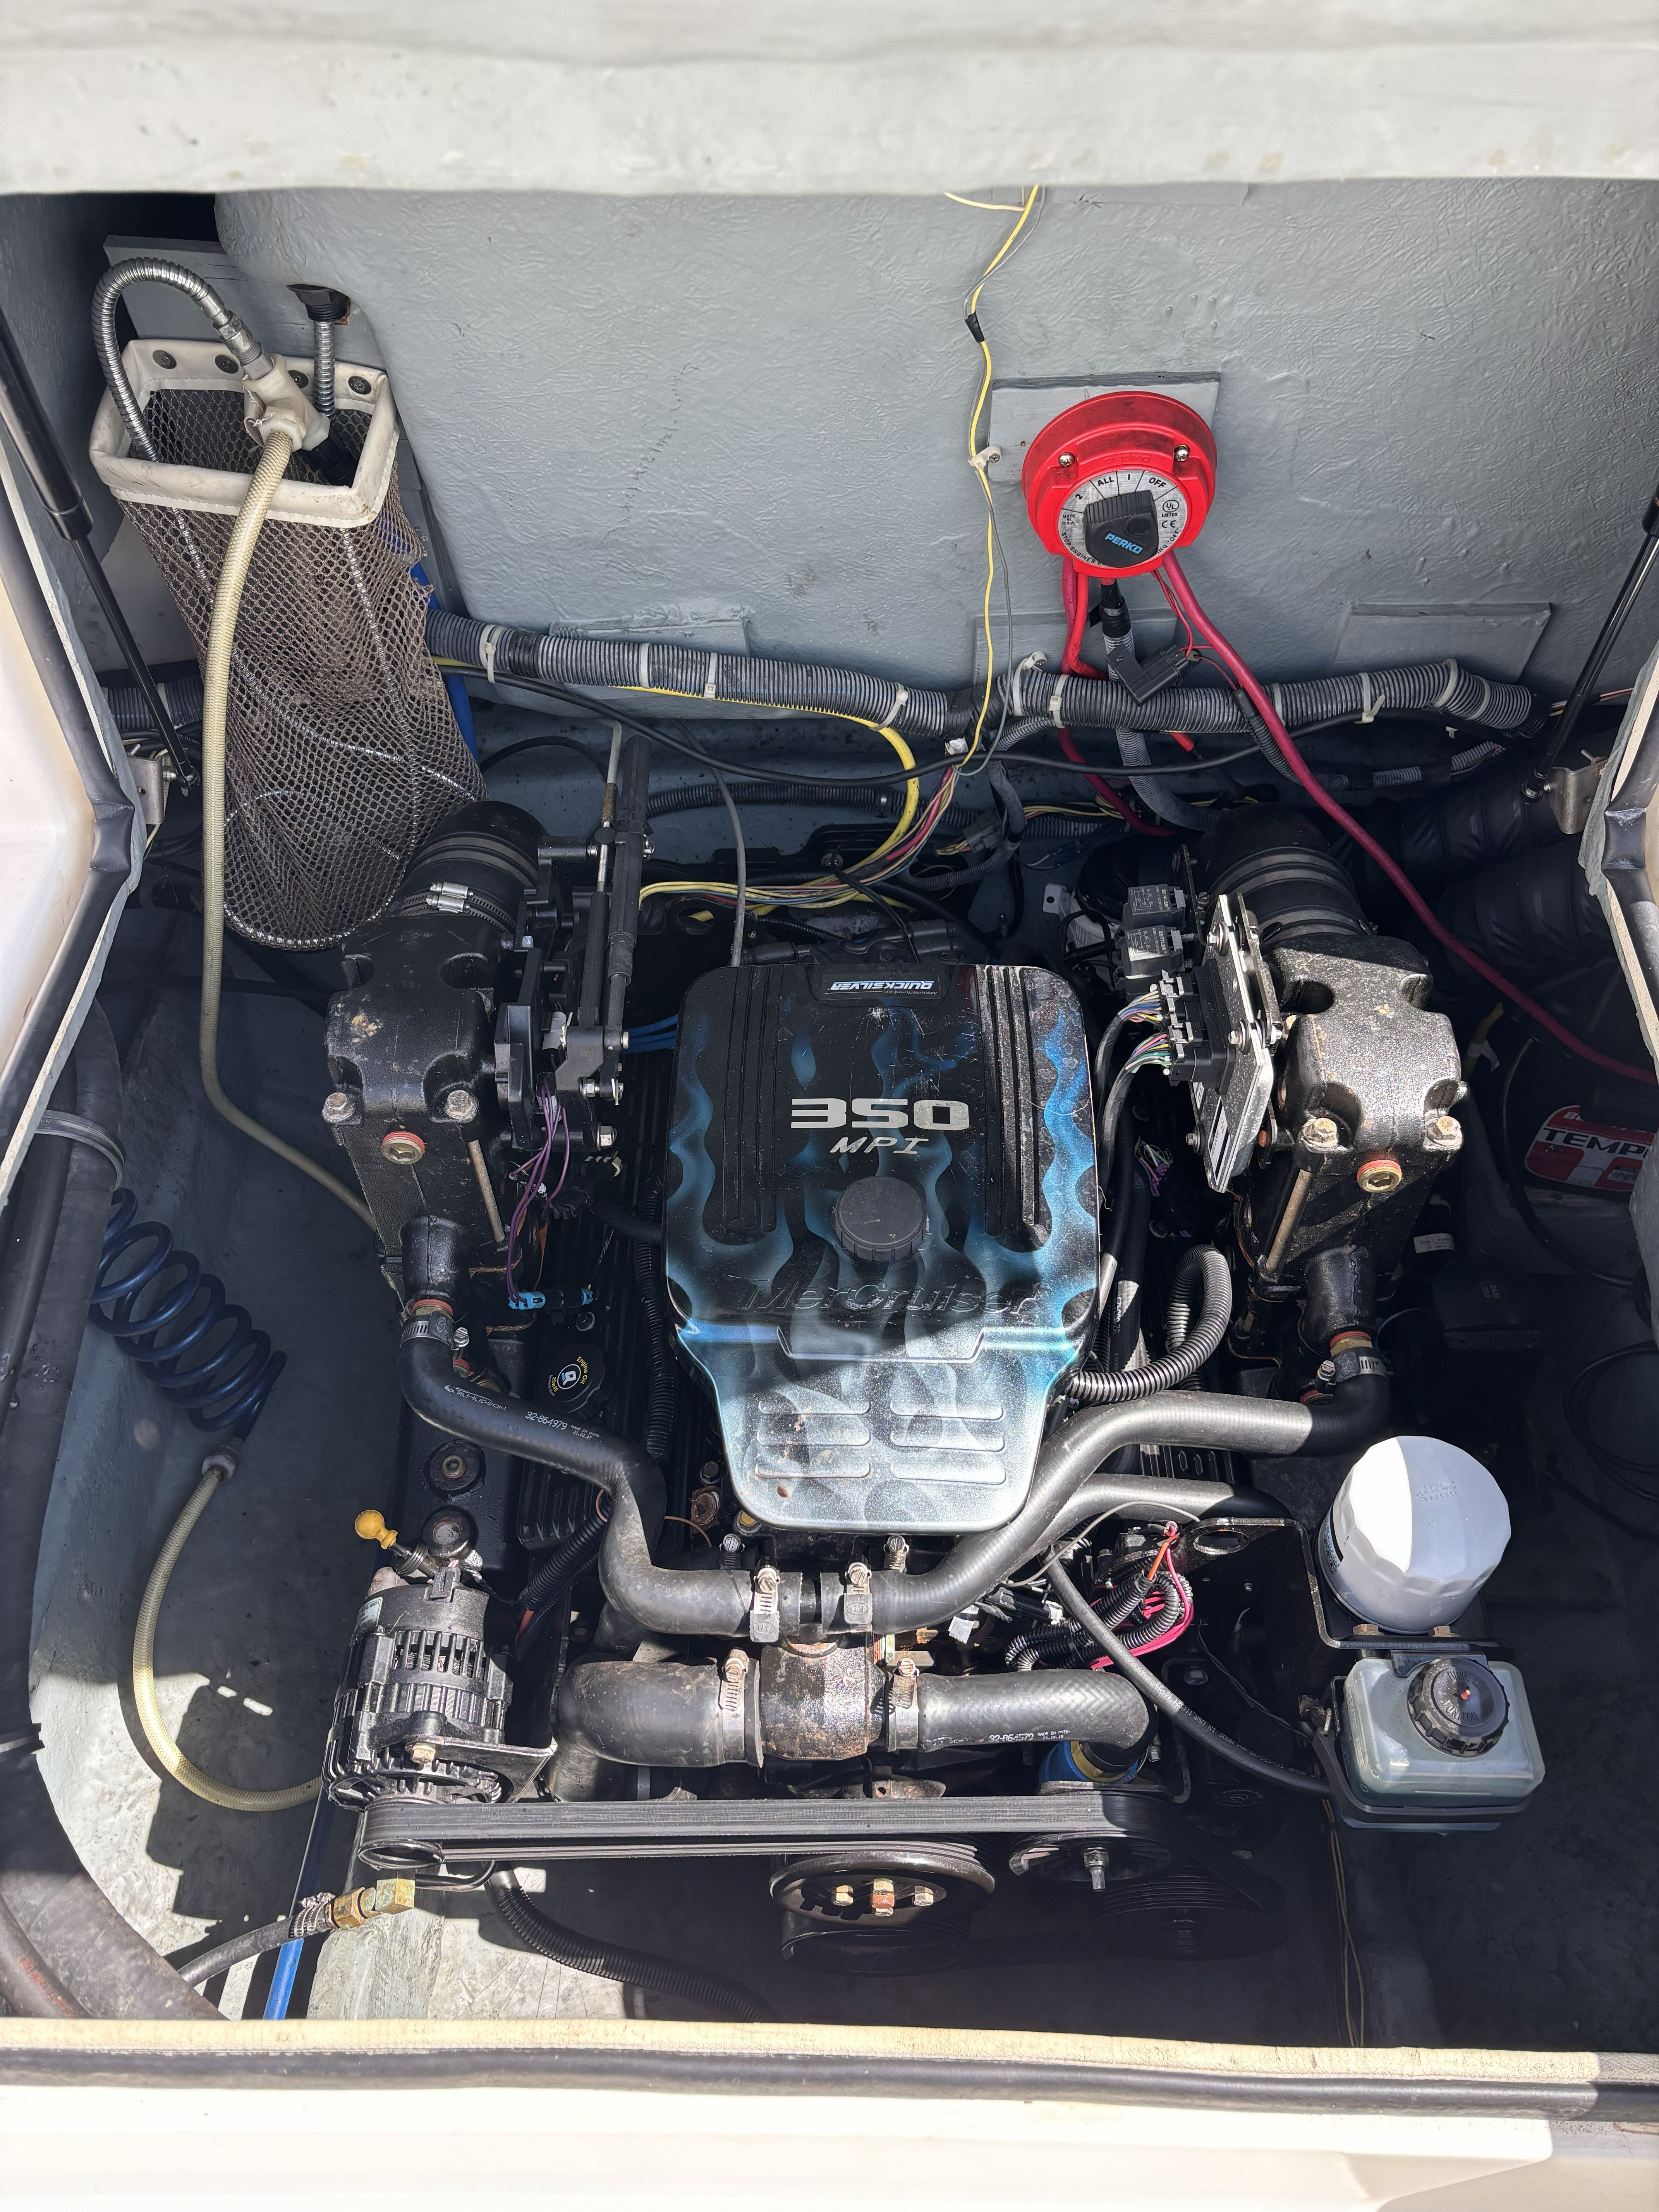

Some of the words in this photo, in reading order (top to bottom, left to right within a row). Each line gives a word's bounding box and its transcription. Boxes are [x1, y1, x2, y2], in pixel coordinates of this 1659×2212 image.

[1097, 477, 1114, 486] ALL
[1149, 477, 1166, 488] OFF
[1061, 532, 1071, 546] STOP
[1070, 547, 1096, 563] ENGINES
[1104, 533, 1143, 554] PERKO
[830, 981, 934, 990] QUICKSILVER
[791, 1097, 969, 1130] 350
[830, 1137, 930, 1154] MPI
[1544, 1128, 1649, 1158] TEMP
[741, 1280, 1041, 1315] MerCruiser
[576, 1356, 588, 1373] Engine
[1447, 1669, 1471, 1682] DRIVE
[1194, 1715, 1206, 1726] USA
